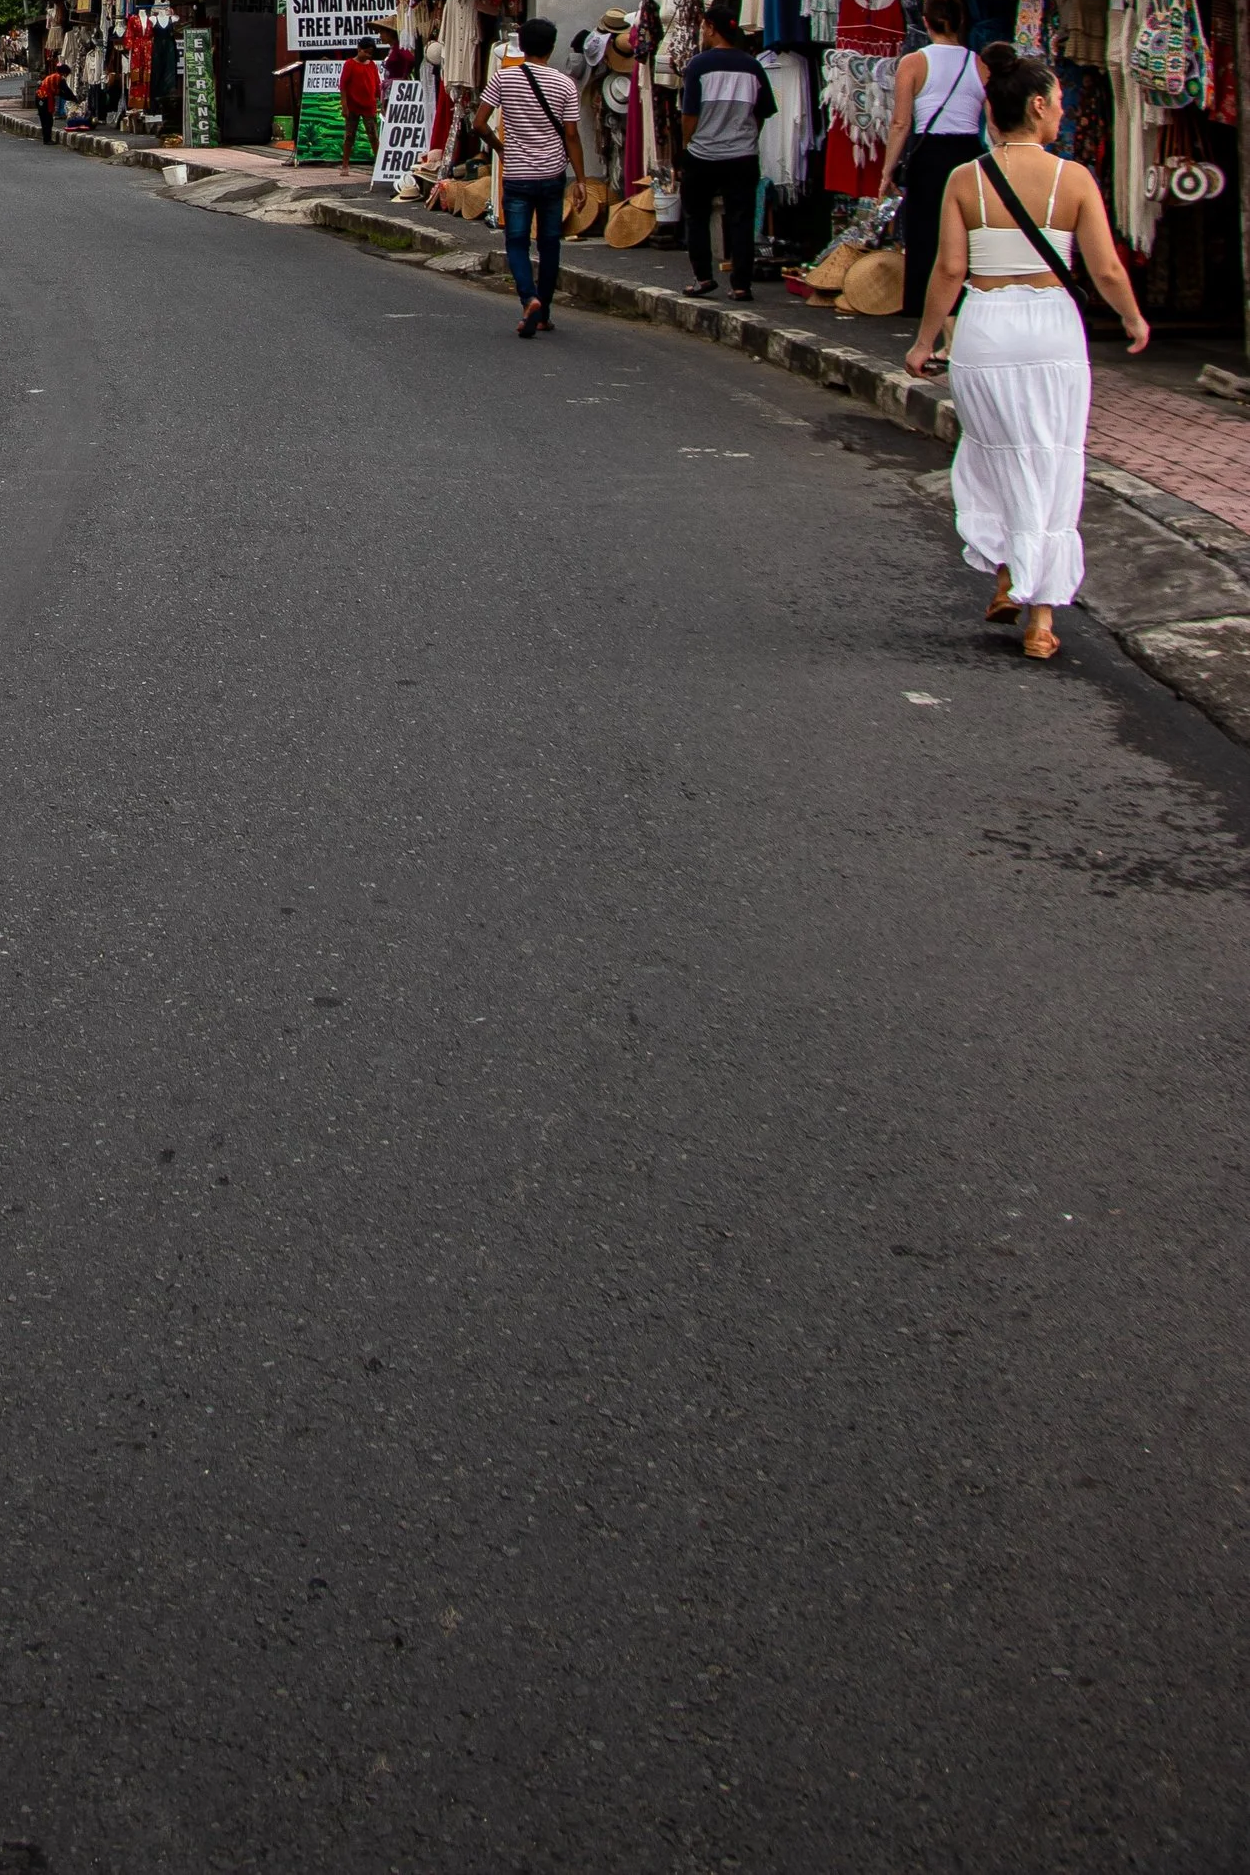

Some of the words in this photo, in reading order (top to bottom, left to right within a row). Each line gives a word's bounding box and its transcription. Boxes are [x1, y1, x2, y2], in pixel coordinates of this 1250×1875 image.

[298, 16, 331, 37] FREE
[298, 39, 348, 47] TEGALLALANG
[308, 63, 333, 75] TREKING
[194, 38, 210, 144] ENTRANCE
[307, 77, 320, 89] RICE
[396, 82, 419, 102] SAI
[388, 103, 424, 124] WARU
